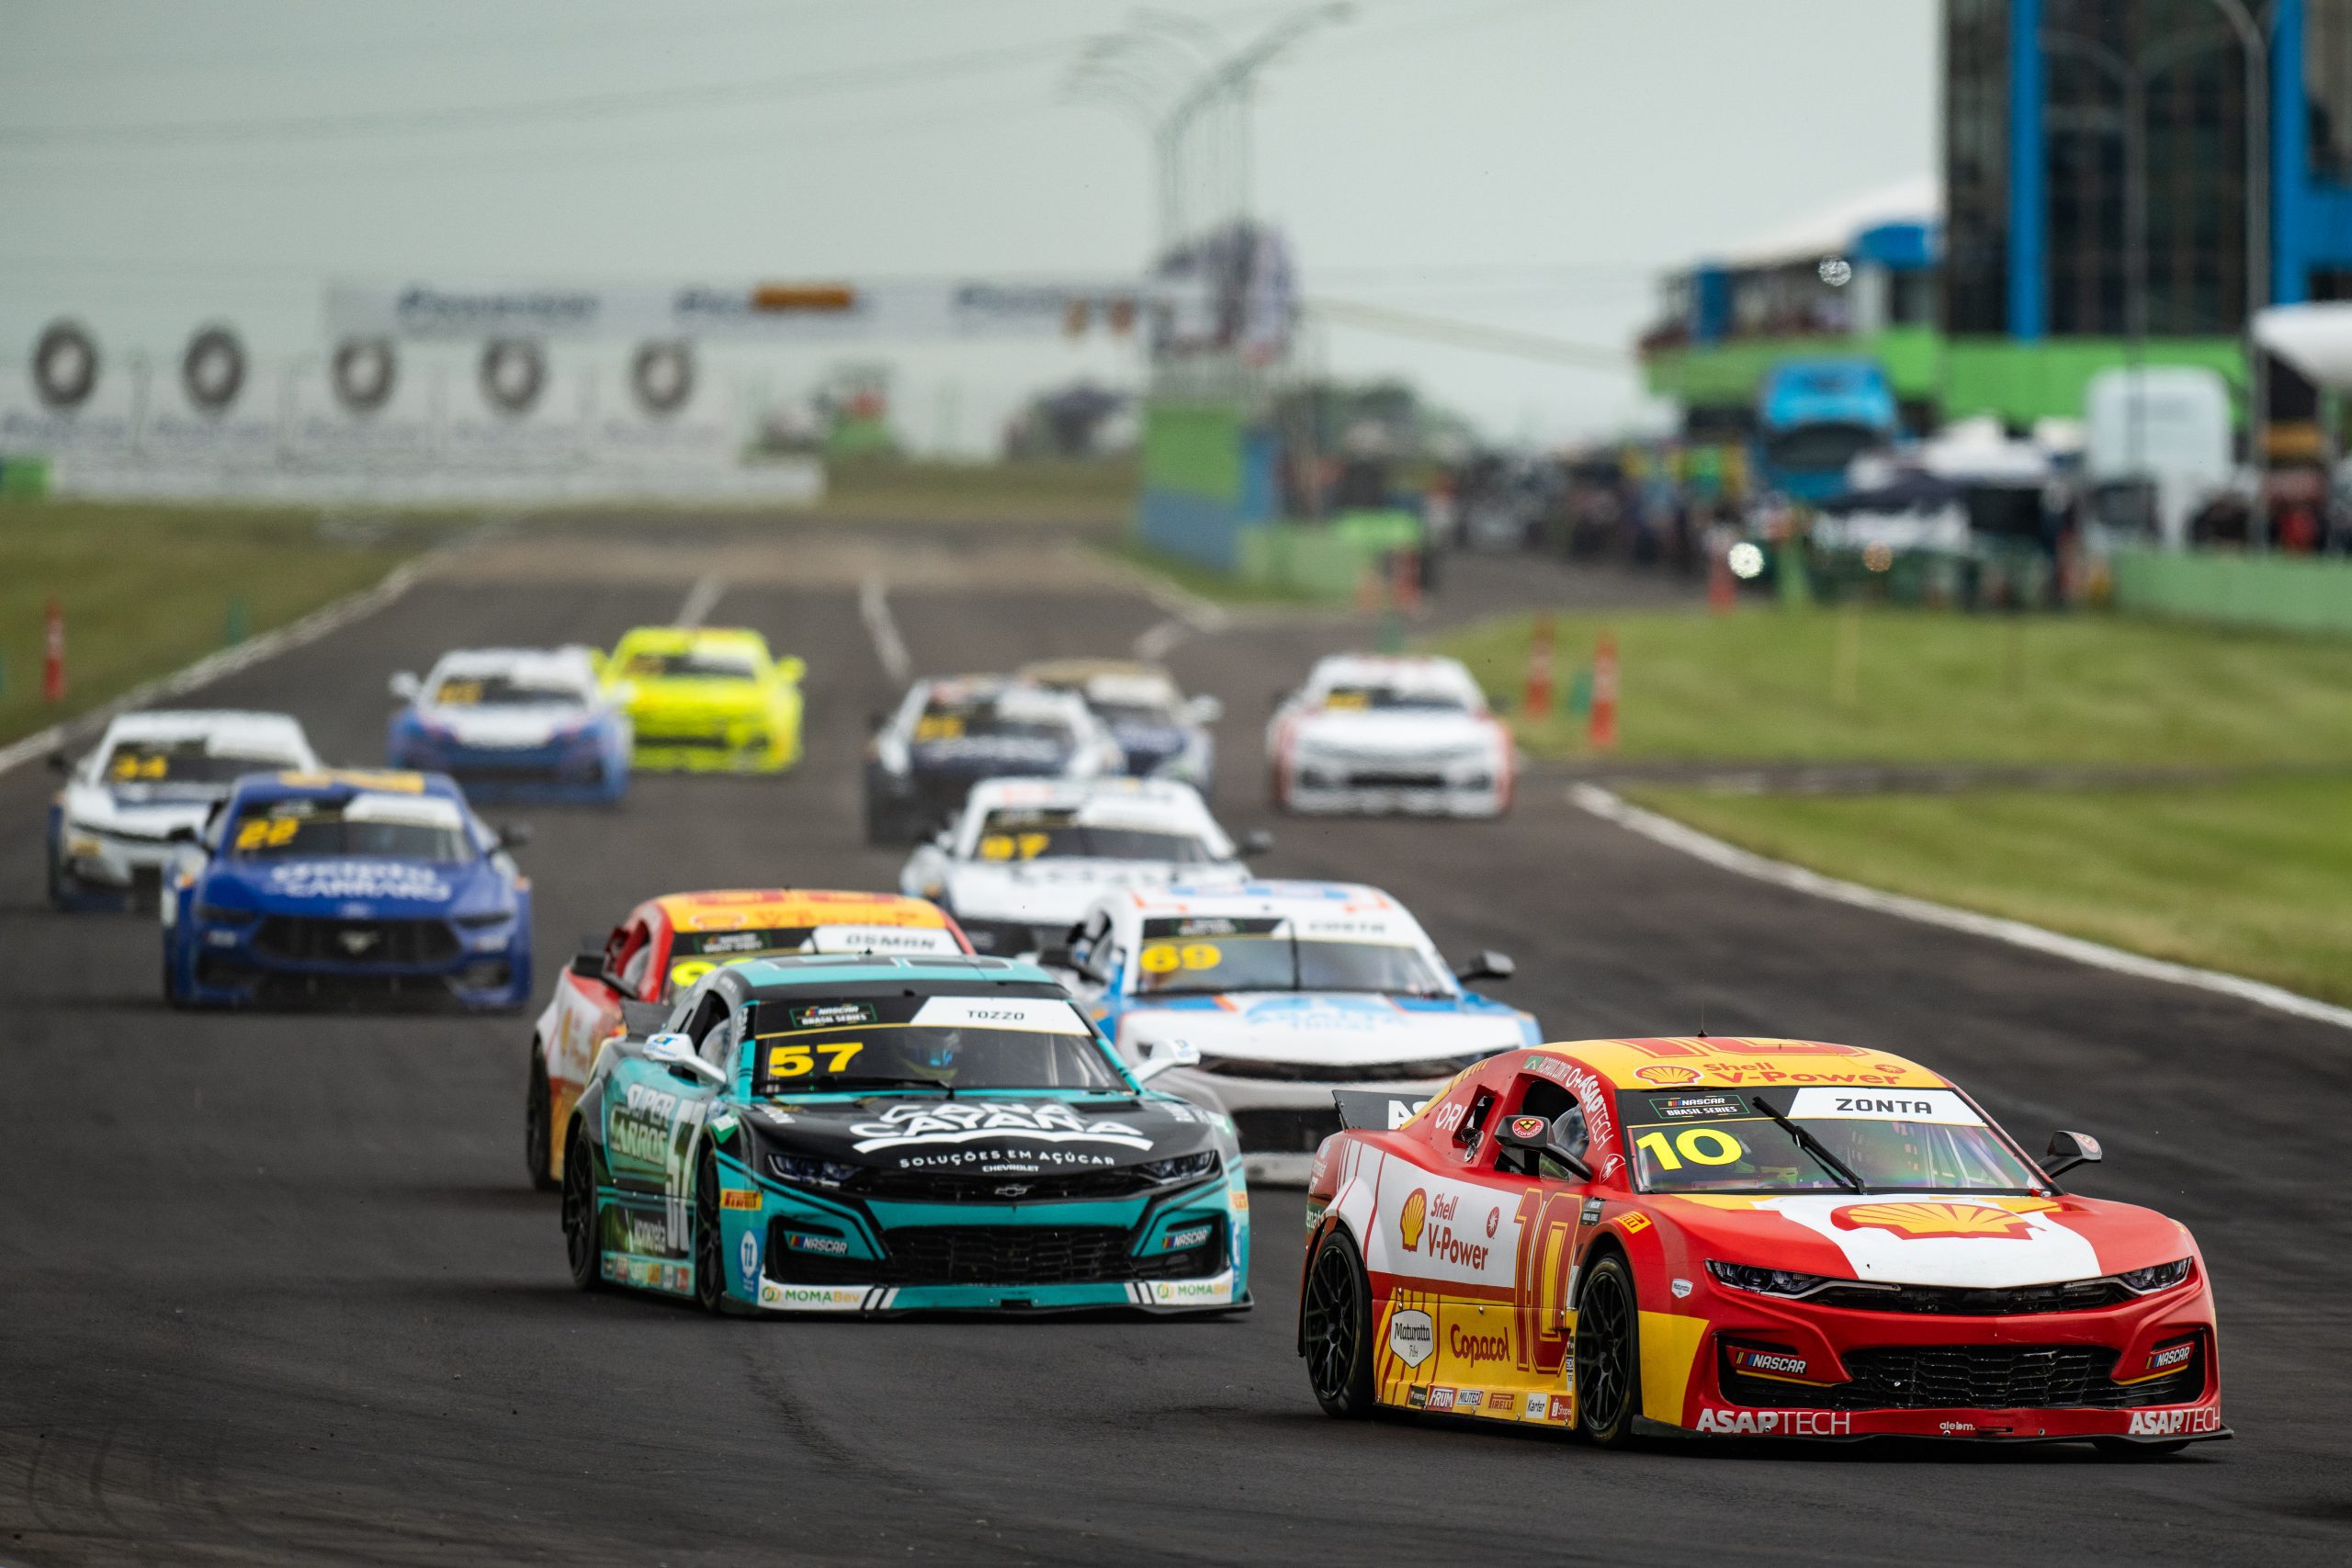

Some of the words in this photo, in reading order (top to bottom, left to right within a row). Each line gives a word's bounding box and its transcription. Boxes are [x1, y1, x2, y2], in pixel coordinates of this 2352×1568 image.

[847, 934, 935, 949] OSMAN
[1140, 943, 1222, 974] 69
[967, 1010, 1025, 1021] TOZZO
[768, 1042, 864, 1077] 57
[1703, 1062, 1775, 1072] Shell
[1712, 1071, 1901, 1085] V-Power
[1579, 1074, 1614, 1151] ASAPTECH
[1666, 1108, 1703, 1117] BRASIL
[1702, 1106, 1738, 1114] SERIES
[1681, 1098, 1725, 1107] NASCAR
[1835, 1098, 1933, 1115] ZONTA
[849, 1112, 1144, 1137] CAYANA
[899, 1150, 1001, 1168] SOLUÇÕES
[1007, 1149, 1032, 1160] EM
[1038, 1151, 1116, 1166] AÇÚCAR
[1635, 1128, 1743, 1171] 10
[981, 1164, 1040, 1172] CHEVROLET
[1430, 1193, 1459, 1222] Shell
[803, 1235, 848, 1255] NASCAR
[1173, 1229, 1208, 1249] NASCAR
[1428, 1223, 1489, 1271] V-Power
[1514, 1187, 1583, 1378] 10
[785, 1290, 861, 1303] MOMABev
[1394, 1322, 1431, 1342] Maturatta
[1450, 1323, 1511, 1369] Copacol
[1752, 1355, 1807, 1374] NASCAR
[2155, 1347, 2190, 1368] NASCAR
[1429, 1388, 1453, 1408] FRUM
[1488, 1392, 1515, 1411] PIRELLI
[1526, 1398, 1545, 1413] Karter
[1696, 1408, 1851, 1436] ASAPTECH
[2128, 1406, 2221, 1436] ASAPTECH
